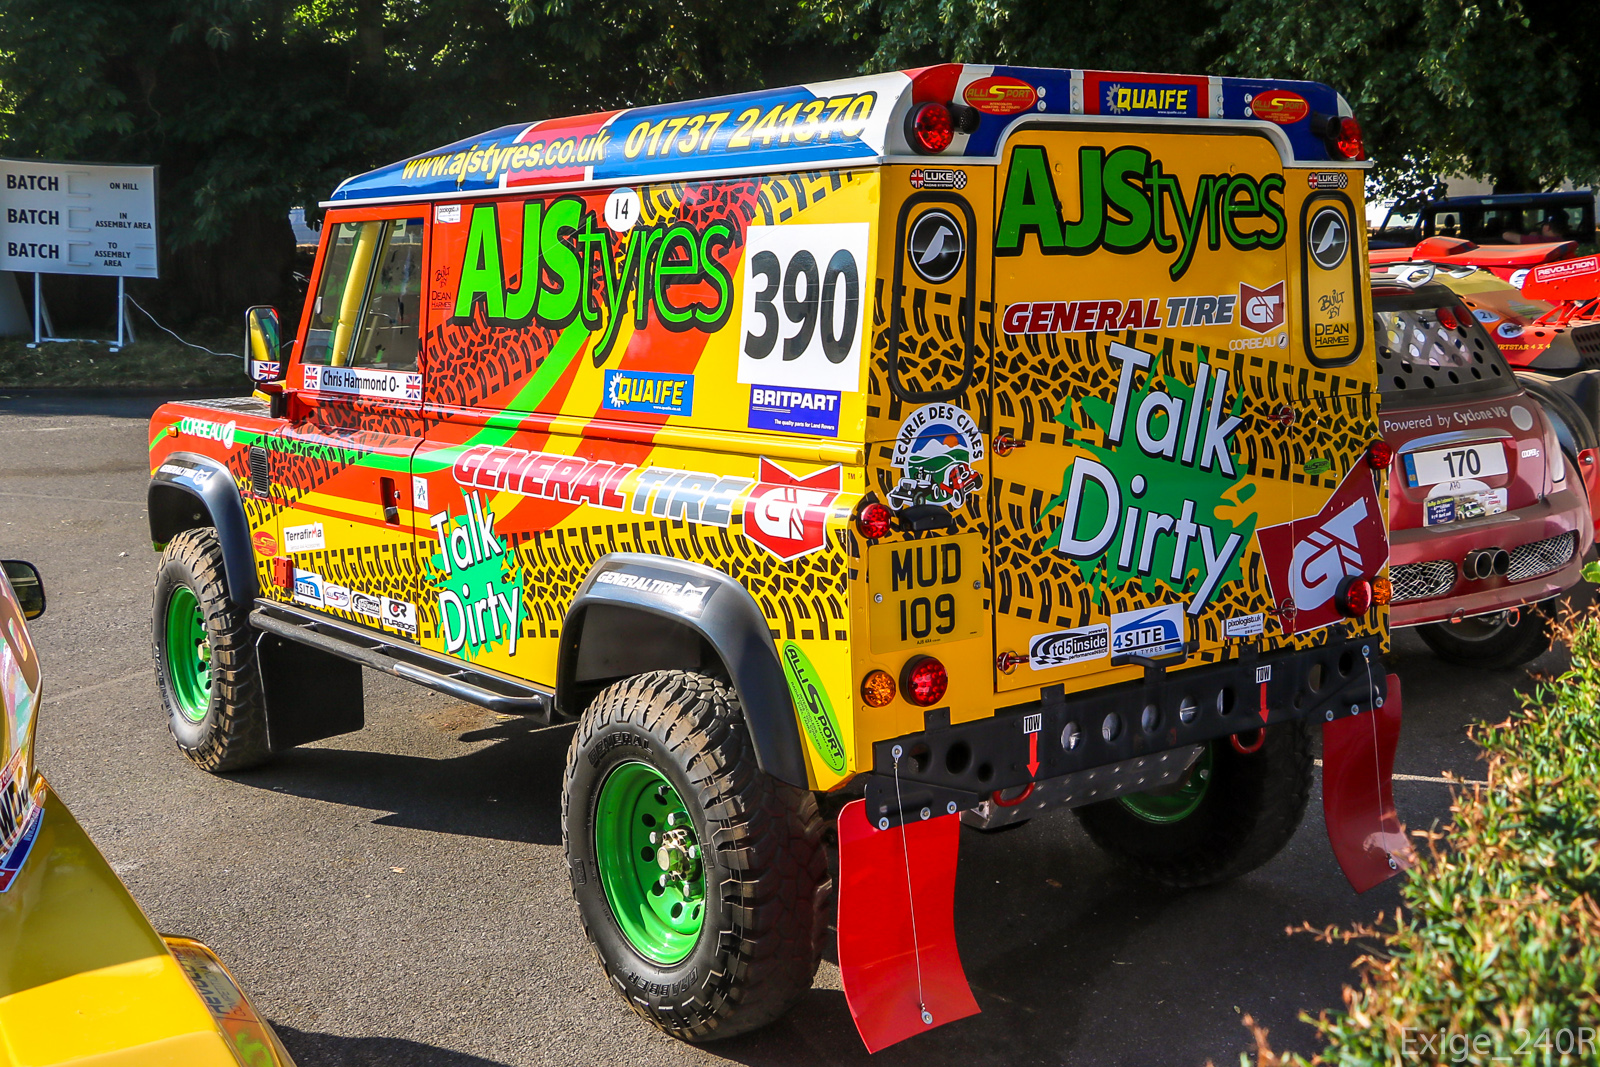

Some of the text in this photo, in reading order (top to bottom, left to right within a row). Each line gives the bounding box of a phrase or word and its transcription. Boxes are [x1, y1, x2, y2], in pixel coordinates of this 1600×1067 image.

[1117, 88, 1188, 111] QUAIFE
[402, 92, 876, 184] www.ajstyres.co.uk 01737 241370
[6, 174, 59, 191] BATCH
[109, 182, 139, 191] ON HILL
[925, 172, 953, 180] LUKE
[7, 208, 59, 225] BATCH
[614, 198, 629, 220] 14
[996, 145, 1287, 282] AJStyres
[95, 220, 152, 230] ASSEMBLY AREA
[7, 242, 59, 259] BATCH
[94, 250, 131, 259] ASSEMBLY
[1537, 260, 1595, 276] REVOLUTION
[453, 196, 734, 367] AJStyres
[431, 290, 451, 301] DEAN
[744, 248, 860, 364] 390
[1002, 294, 1238, 335] GENERAL TIRE
[1246, 295, 1280, 323] GT
[1327, 304, 1341, 319] BY
[1480, 311, 1493, 319] 21
[1315, 323, 1349, 336] DEAN
[1315, 336, 1349, 345] HARMES
[1229, 337, 1276, 351] CORBEAU
[322, 370, 342, 387] Chris
[344, 373, 387, 391] Hammond
[616, 377, 685, 405] QUAIFE
[752, 389, 838, 411] BRITPART
[1108, 341, 1246, 479] Talk
[181, 417, 223, 441] CORBEAU
[1384, 406, 1508, 433] Powered by Cyclone V8
[894, 406, 983, 465] ECURIE DES CIMES
[1443, 449, 1481, 478] 170
[1521, 449, 1536, 458] COOPER
[452, 444, 638, 511] GENERAL
[630, 466, 754, 527] TIRE
[755, 487, 826, 540] GT
[430, 489, 504, 576] Talk
[1058, 456, 1244, 616] Dirty
[1288, 497, 1368, 611] GT
[891, 543, 961, 592] MUD
[383, 616, 415, 632] TURBOS
[439, 581, 520, 657] Dirty
[900, 593, 955, 641] 109
[1228, 615, 1261, 629] pixologist.uk
[1113, 627, 1162, 648] 4SITE
[1141, 646, 1163, 655] TYRES
[1257, 667, 1270, 682] TOW
[787, 648, 844, 760] ALLISPORT
[1025, 714, 1041, 732] TOW
[588, 731, 653, 768] GENERAL
[628, 967, 698, 997] GRABBER
